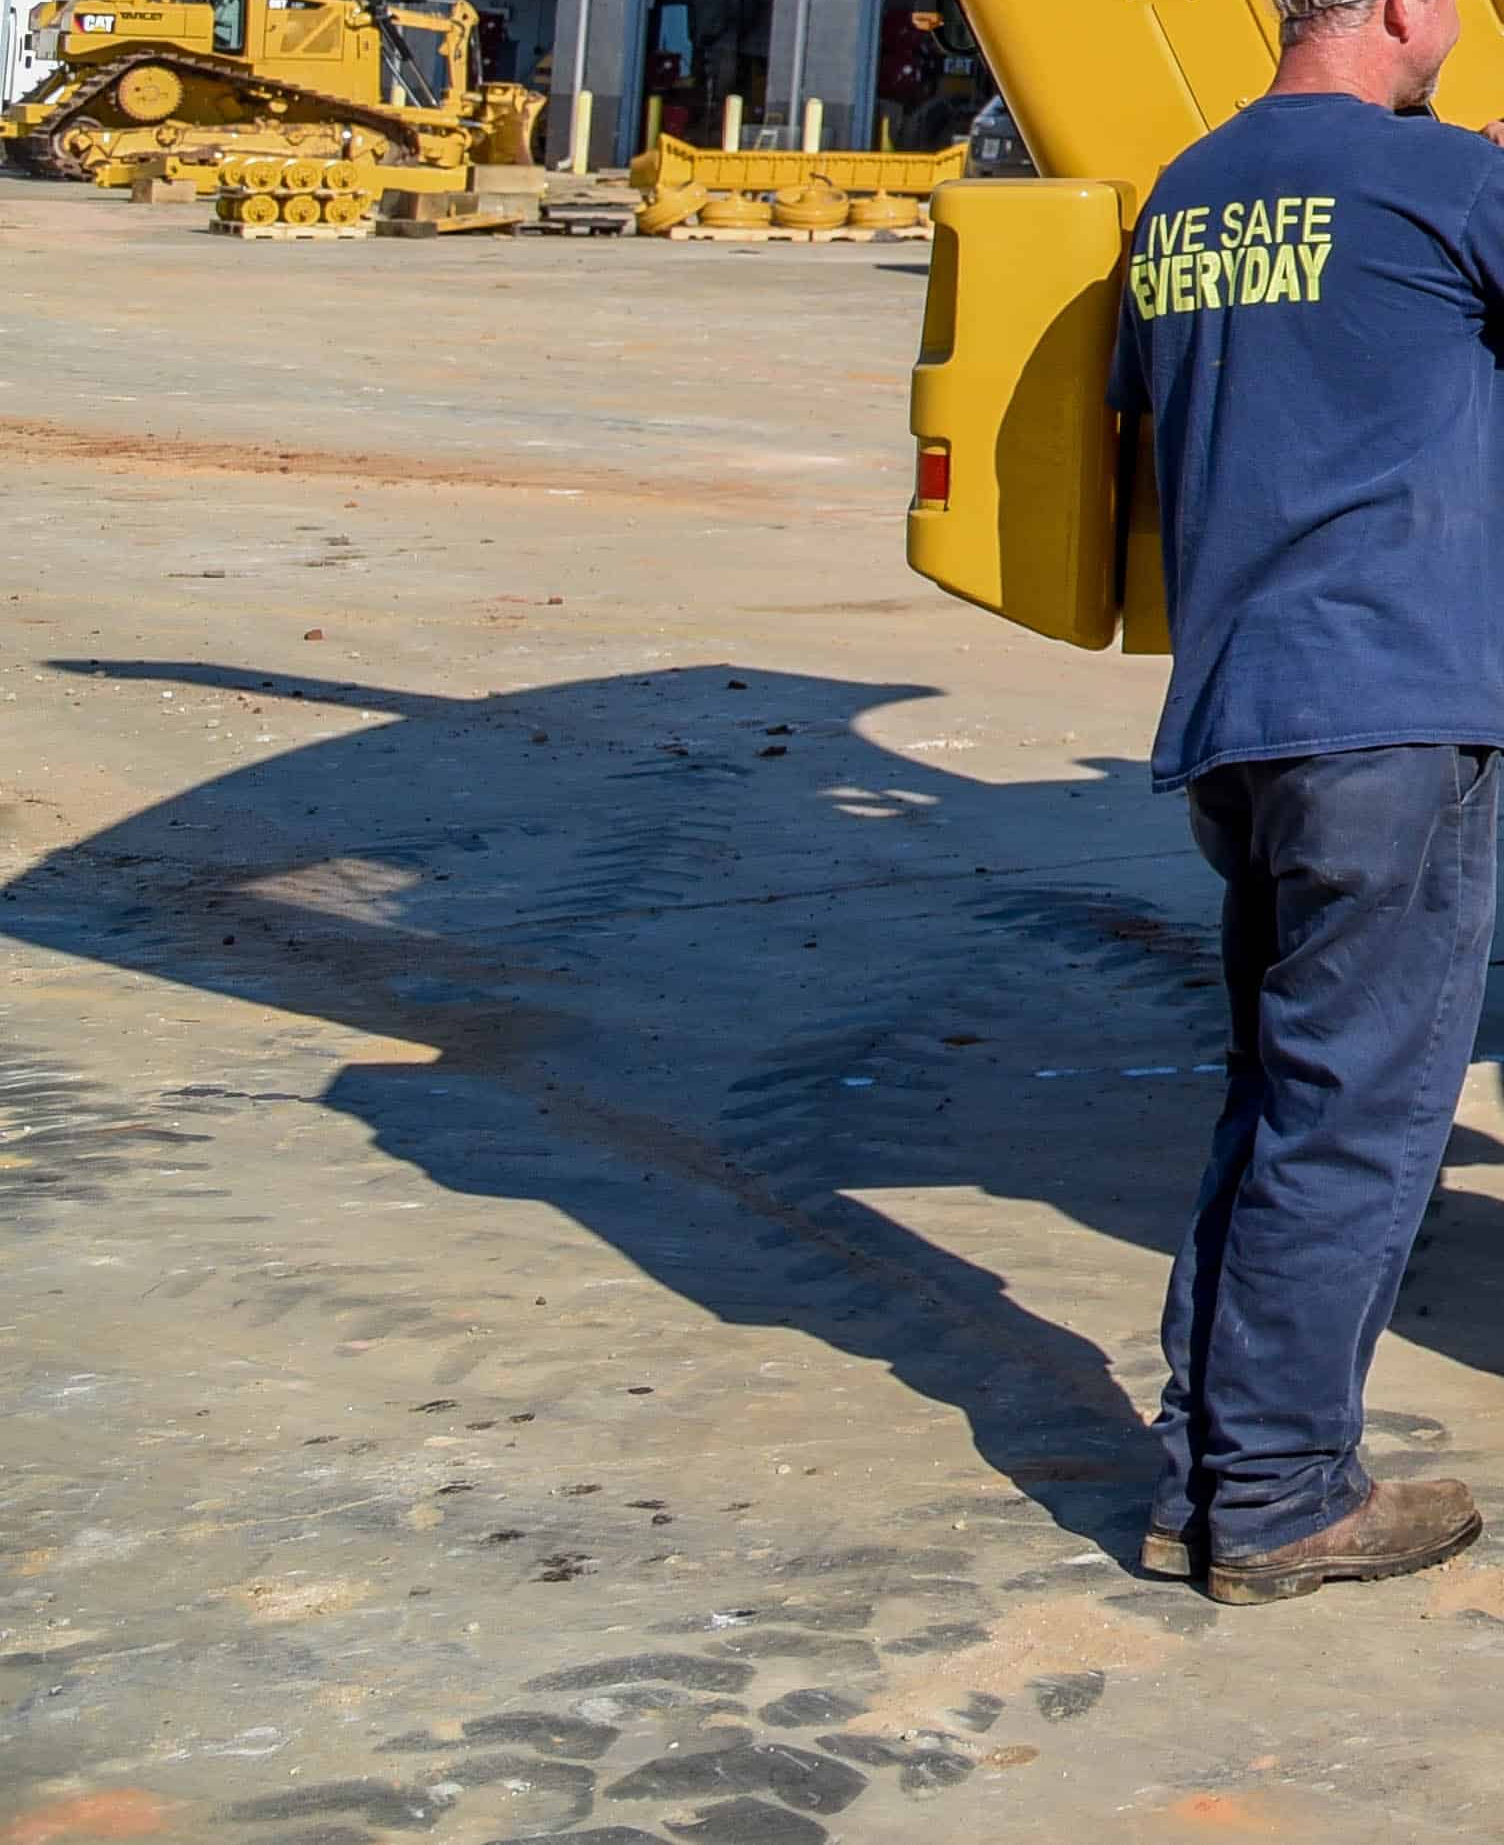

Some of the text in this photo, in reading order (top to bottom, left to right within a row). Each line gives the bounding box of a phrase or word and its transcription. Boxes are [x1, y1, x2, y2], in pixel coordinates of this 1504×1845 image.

[82, 14, 115, 32] CAT
[1220, 197, 1336, 249] SAFE
[1130, 243, 1333, 321] EVERYDAY
